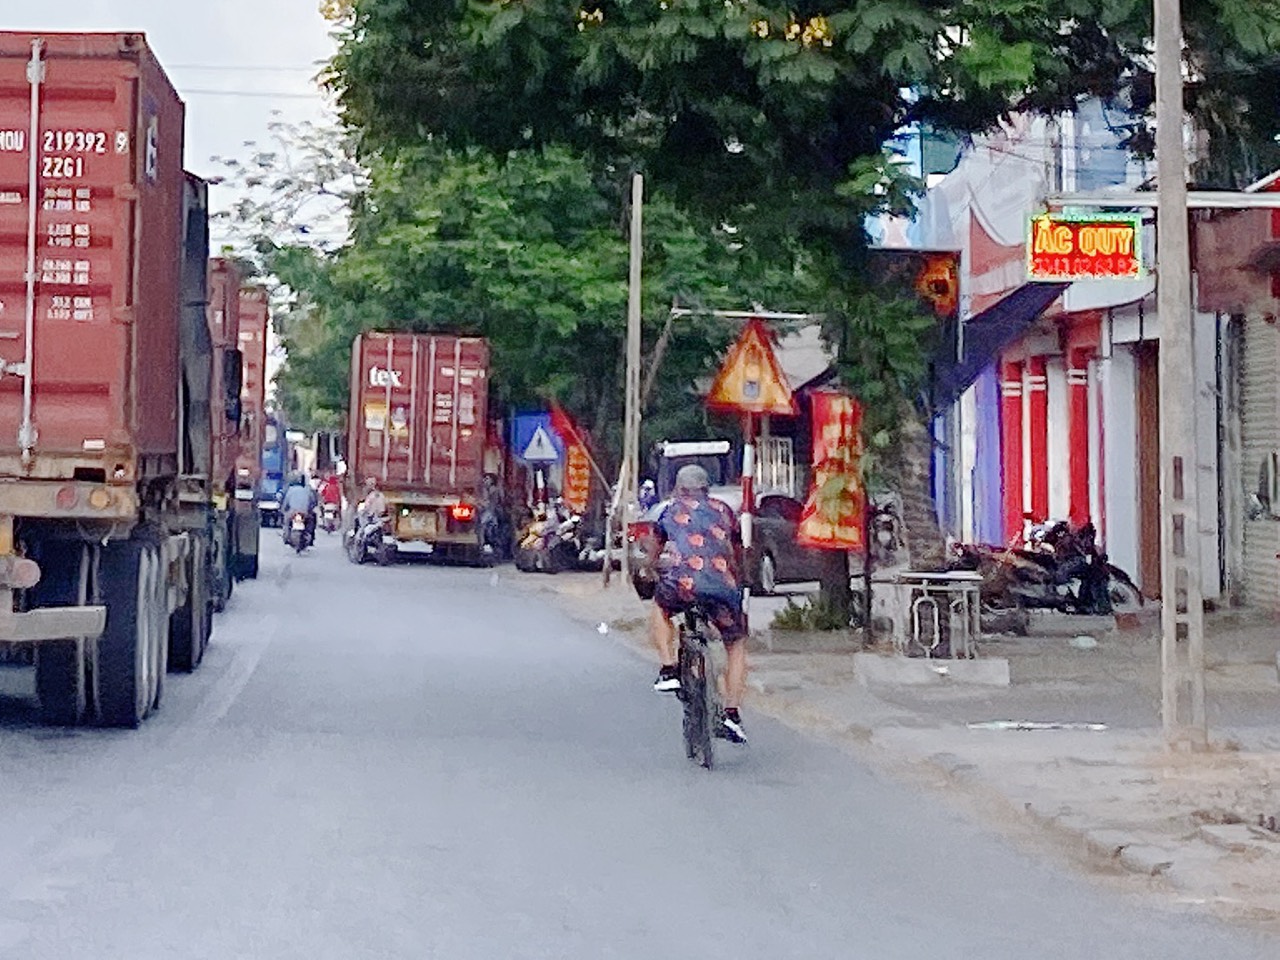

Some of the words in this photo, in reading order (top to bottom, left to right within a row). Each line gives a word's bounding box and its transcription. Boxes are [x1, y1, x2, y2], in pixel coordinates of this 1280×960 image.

[43, 131, 106, 153] 219392
[116, 131, 128, 153] 9
[368, 365, 402, 388] tex
